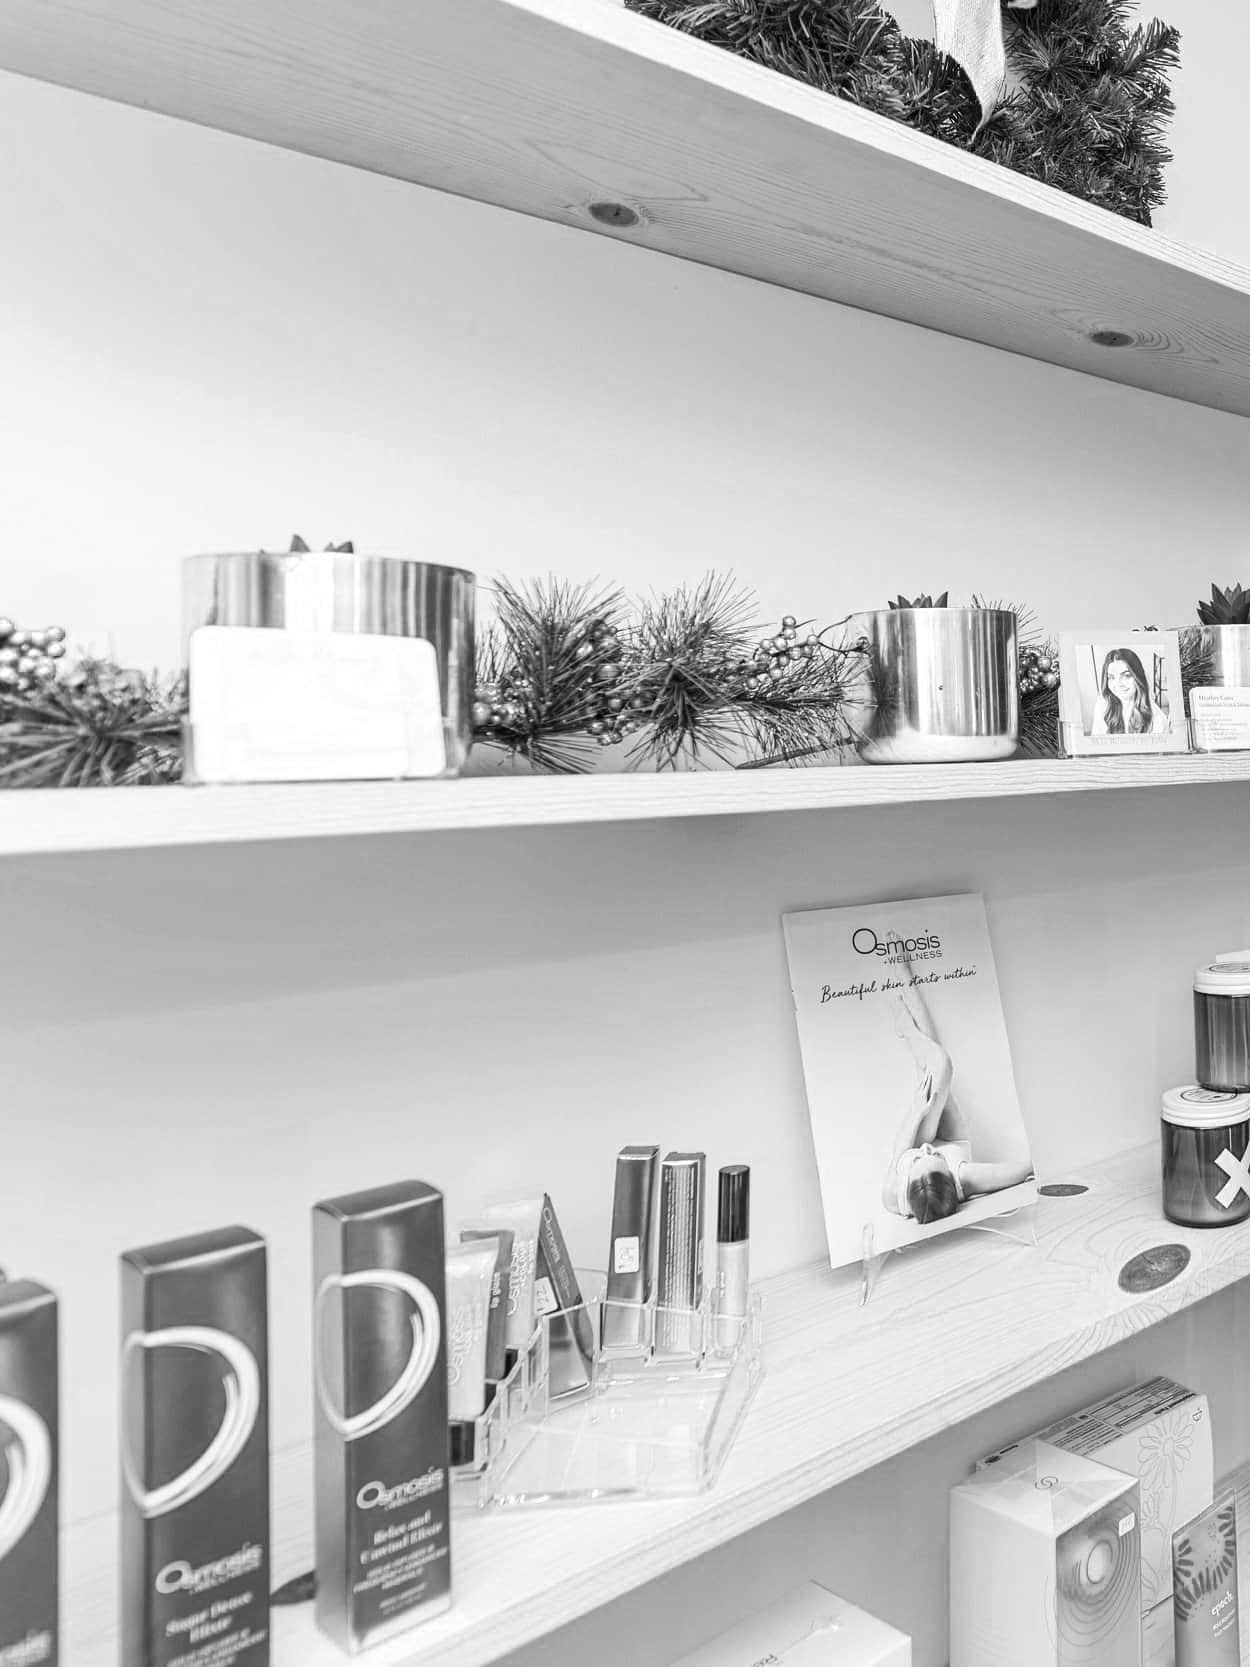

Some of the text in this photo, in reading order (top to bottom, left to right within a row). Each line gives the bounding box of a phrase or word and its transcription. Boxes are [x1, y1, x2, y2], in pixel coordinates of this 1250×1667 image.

[852, 928, 941, 956] Osmosis
[820, 980, 877, 1003] Beautiful
[881, 979, 905, 992] skin
[908, 971, 941, 988] starts
[356, 1467, 445, 1509] Osmosis
